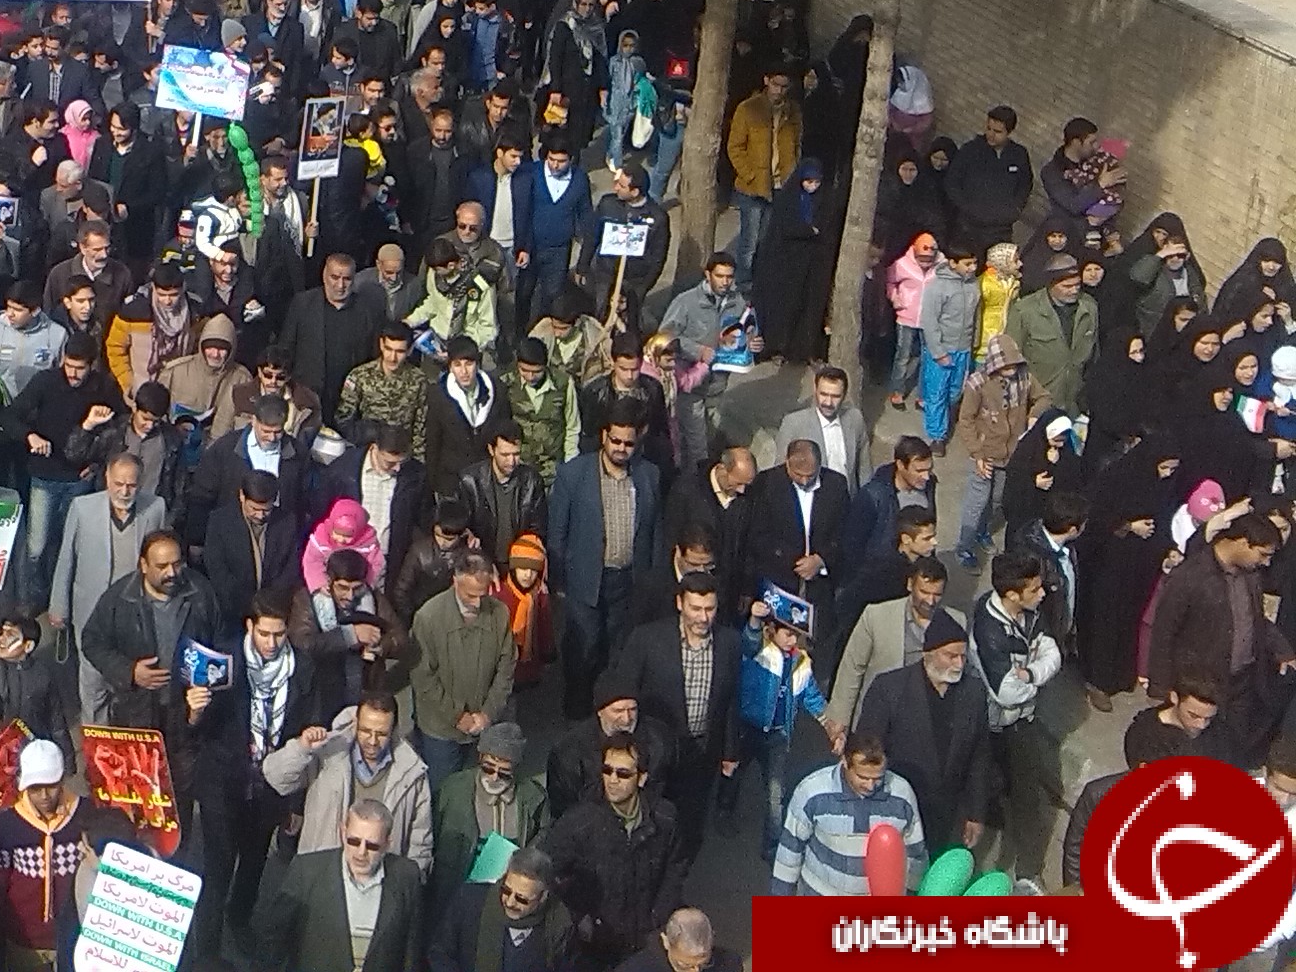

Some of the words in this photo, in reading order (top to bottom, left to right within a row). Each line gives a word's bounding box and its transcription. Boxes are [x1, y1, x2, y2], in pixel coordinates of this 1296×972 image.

[84, 728, 112, 740] DOWN
[112, 731, 136, 741] WITH
[97, 787, 110, 801] ما
[111, 789, 144, 804] ملت
[148, 793, 172, 809] شعار
[150, 815, 178, 832] مرگ
[151, 873, 165, 884] بر
[168, 874, 194, 892] مرگ
[94, 896, 125, 916] DOWN
[127, 909, 155, 928] WITH
[149, 902, 186, 924] الموت
[84, 928, 113, 948] DOWN
[113, 940, 140, 959] WITH
[142, 934, 179, 956] الموت
